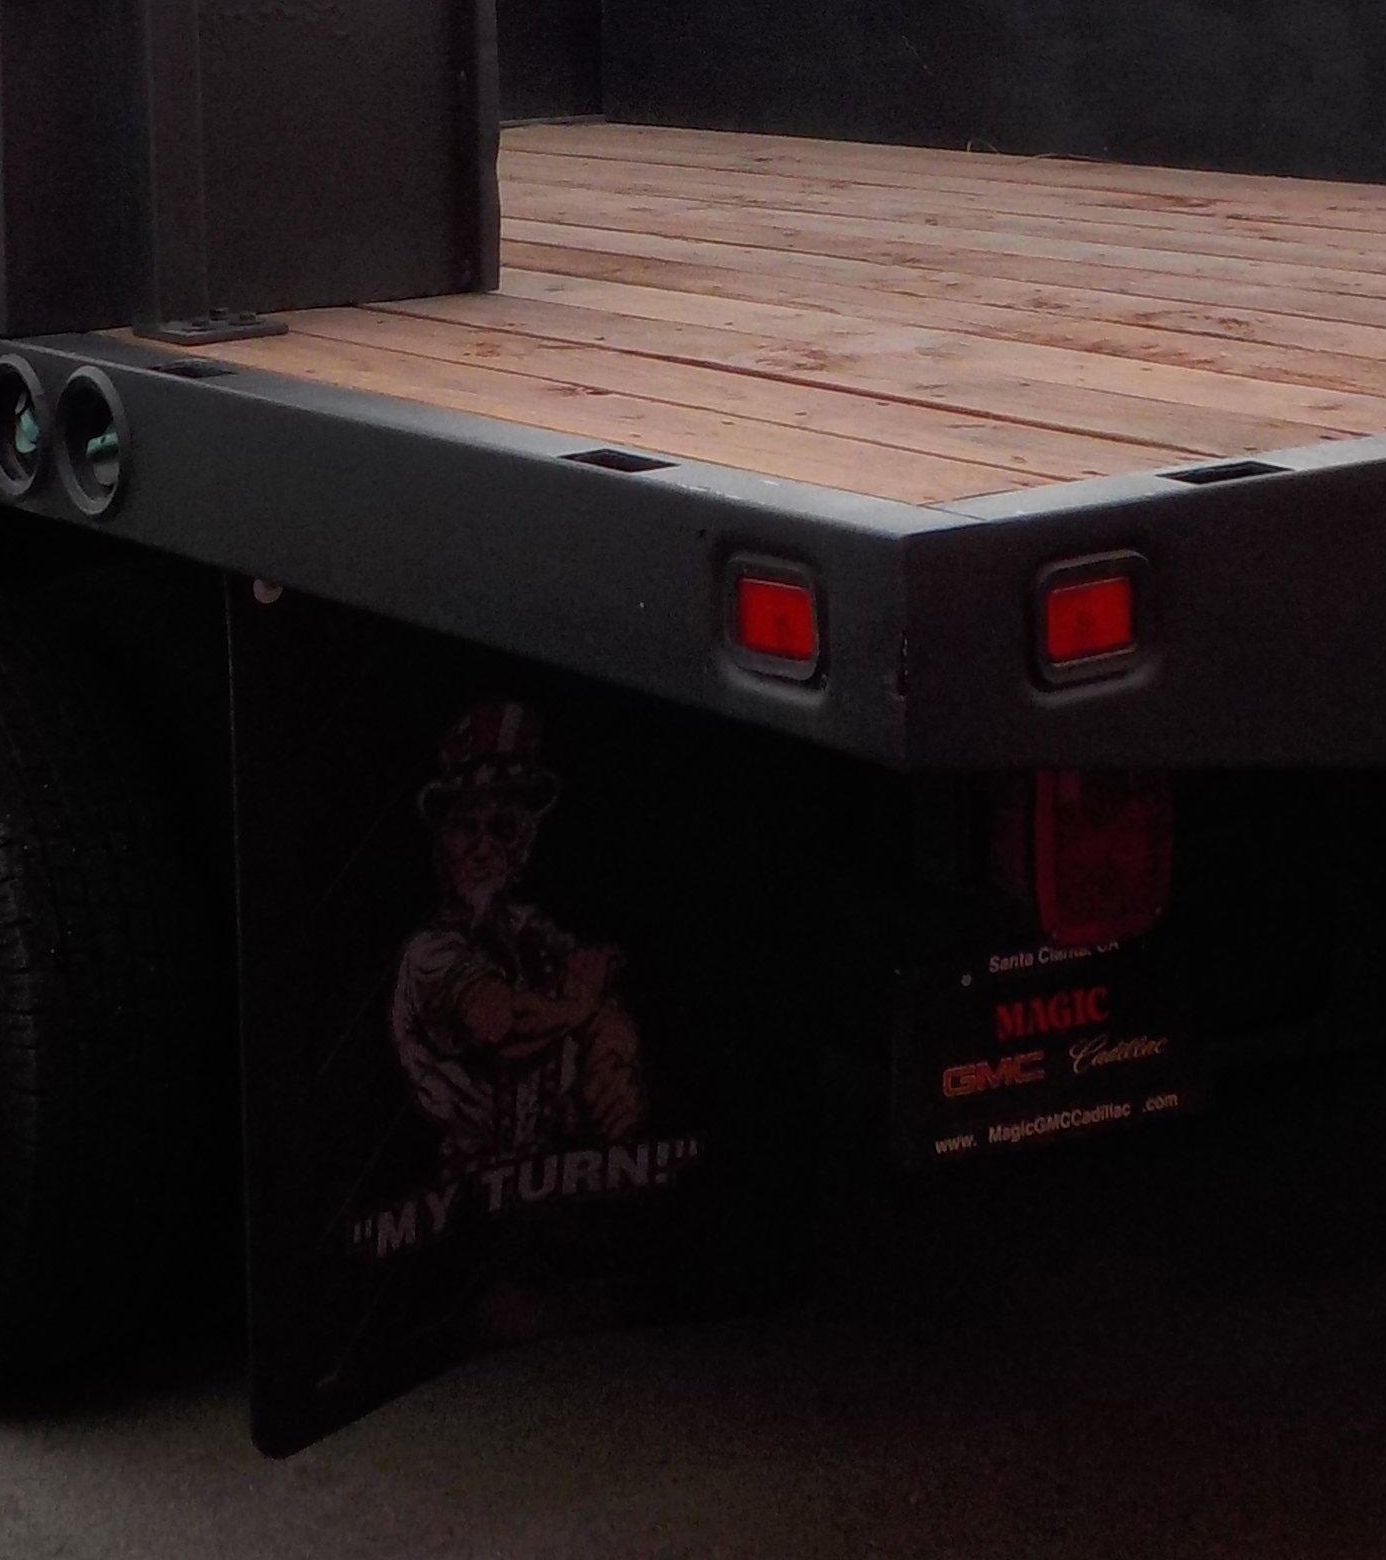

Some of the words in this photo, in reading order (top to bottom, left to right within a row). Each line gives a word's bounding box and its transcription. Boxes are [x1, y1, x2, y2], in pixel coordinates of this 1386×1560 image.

[988, 952, 1034, 974] Santa
[995, 984, 1110, 1044] MAGIC
[941, 1049, 1046, 1099] GMC
